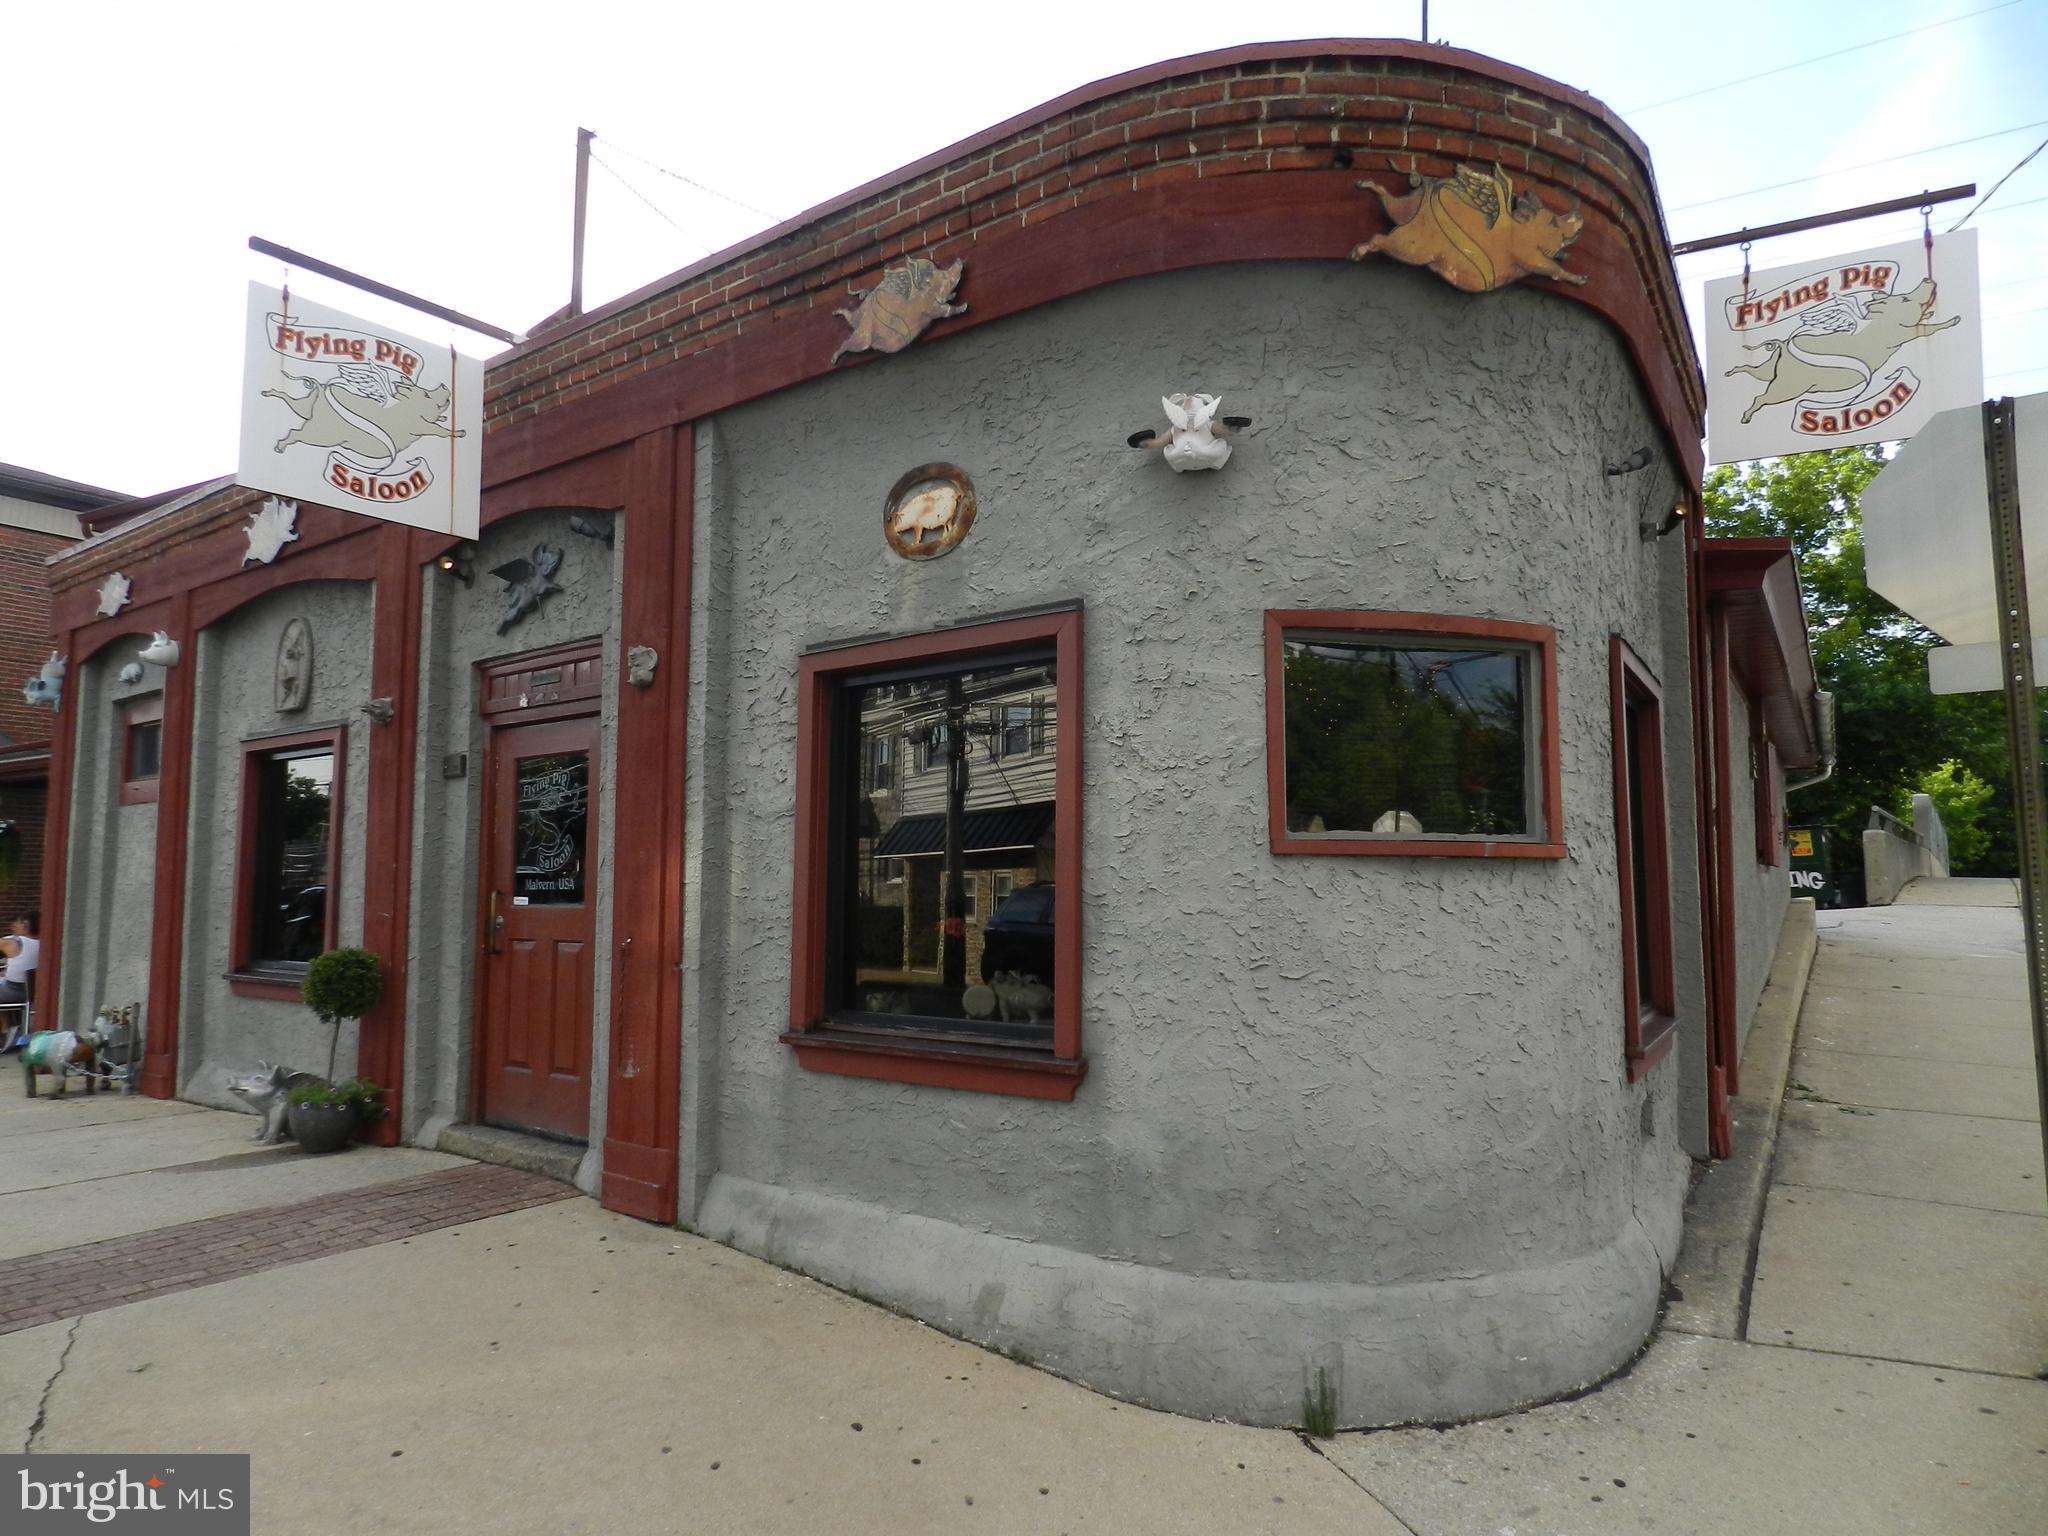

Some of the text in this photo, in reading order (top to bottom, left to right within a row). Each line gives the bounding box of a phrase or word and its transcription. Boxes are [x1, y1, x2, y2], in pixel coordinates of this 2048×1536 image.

[1735, 264, 1892, 328] Flying Pig
[275, 325, 418, 376] Flying Pig
[1800, 381, 1913, 433] Saloon
[331, 463, 428, 499] Saloon
[538, 844, 571, 869] Saloon
[558, 877, 575, 890] USA
